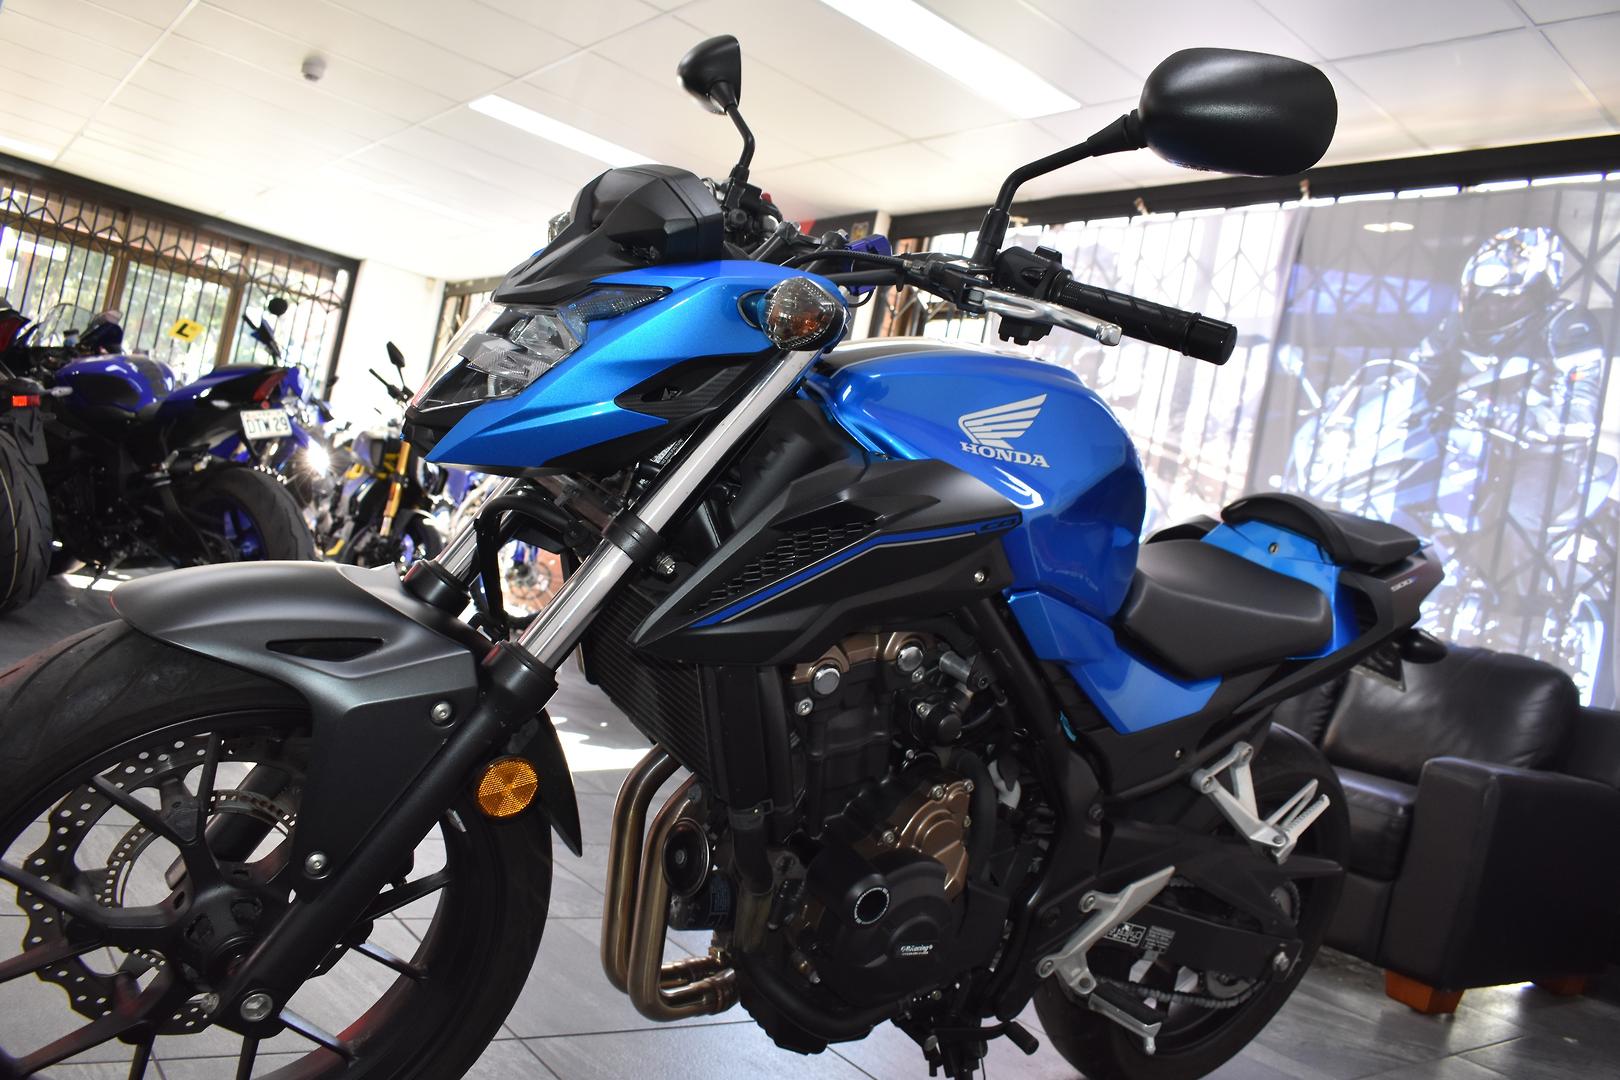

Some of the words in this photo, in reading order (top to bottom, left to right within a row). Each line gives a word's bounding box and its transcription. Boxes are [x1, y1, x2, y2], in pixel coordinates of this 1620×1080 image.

[176, 323, 189, 337] L
[273, 416, 289, 432] 29
[959, 441, 1050, 468] HONDA
